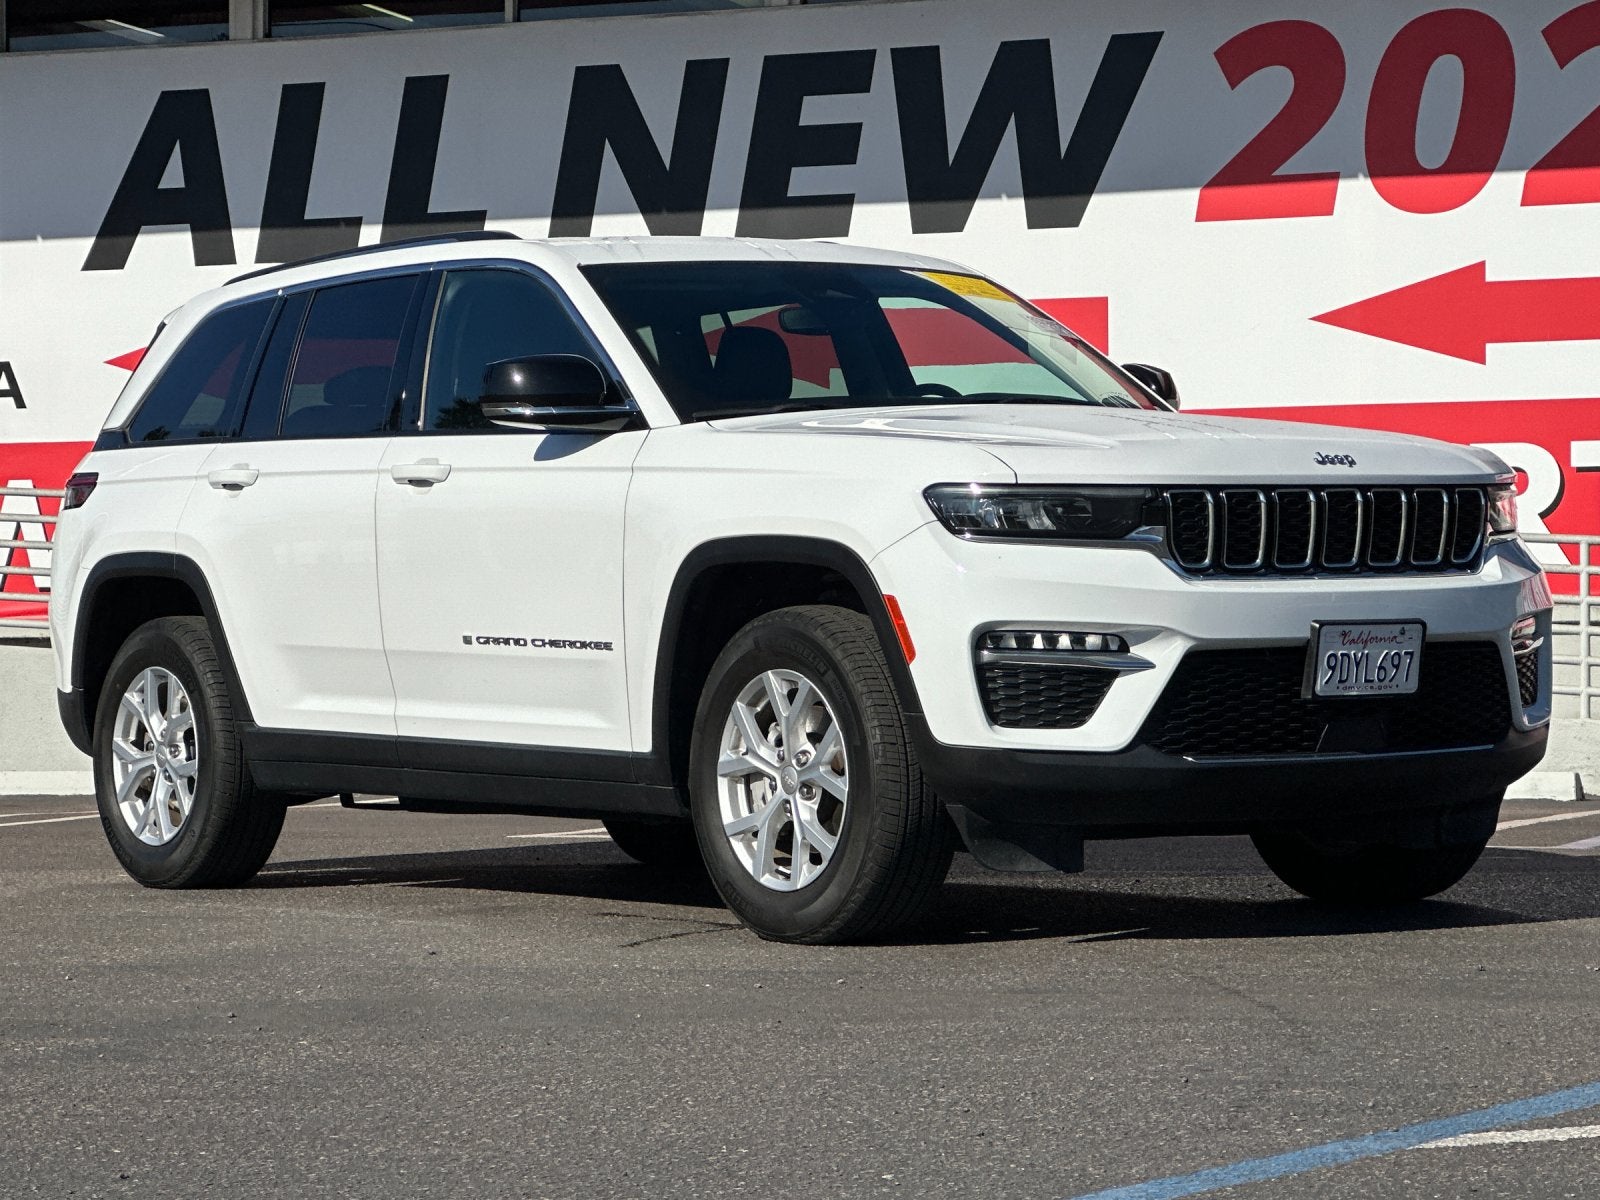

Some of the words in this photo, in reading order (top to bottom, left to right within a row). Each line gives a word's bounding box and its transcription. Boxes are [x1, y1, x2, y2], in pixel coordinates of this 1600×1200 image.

[82, 74, 487, 271] ALL
[549, 31, 1164, 239] NEW
[1313, 452, 1357, 468] Jeep
[475, 635, 527, 647] GRAND
[531, 638, 614, 651] CHEROKEE
[1341, 630, 1404, 650] California
[1323, 650, 1415, 685] 9DYL697
